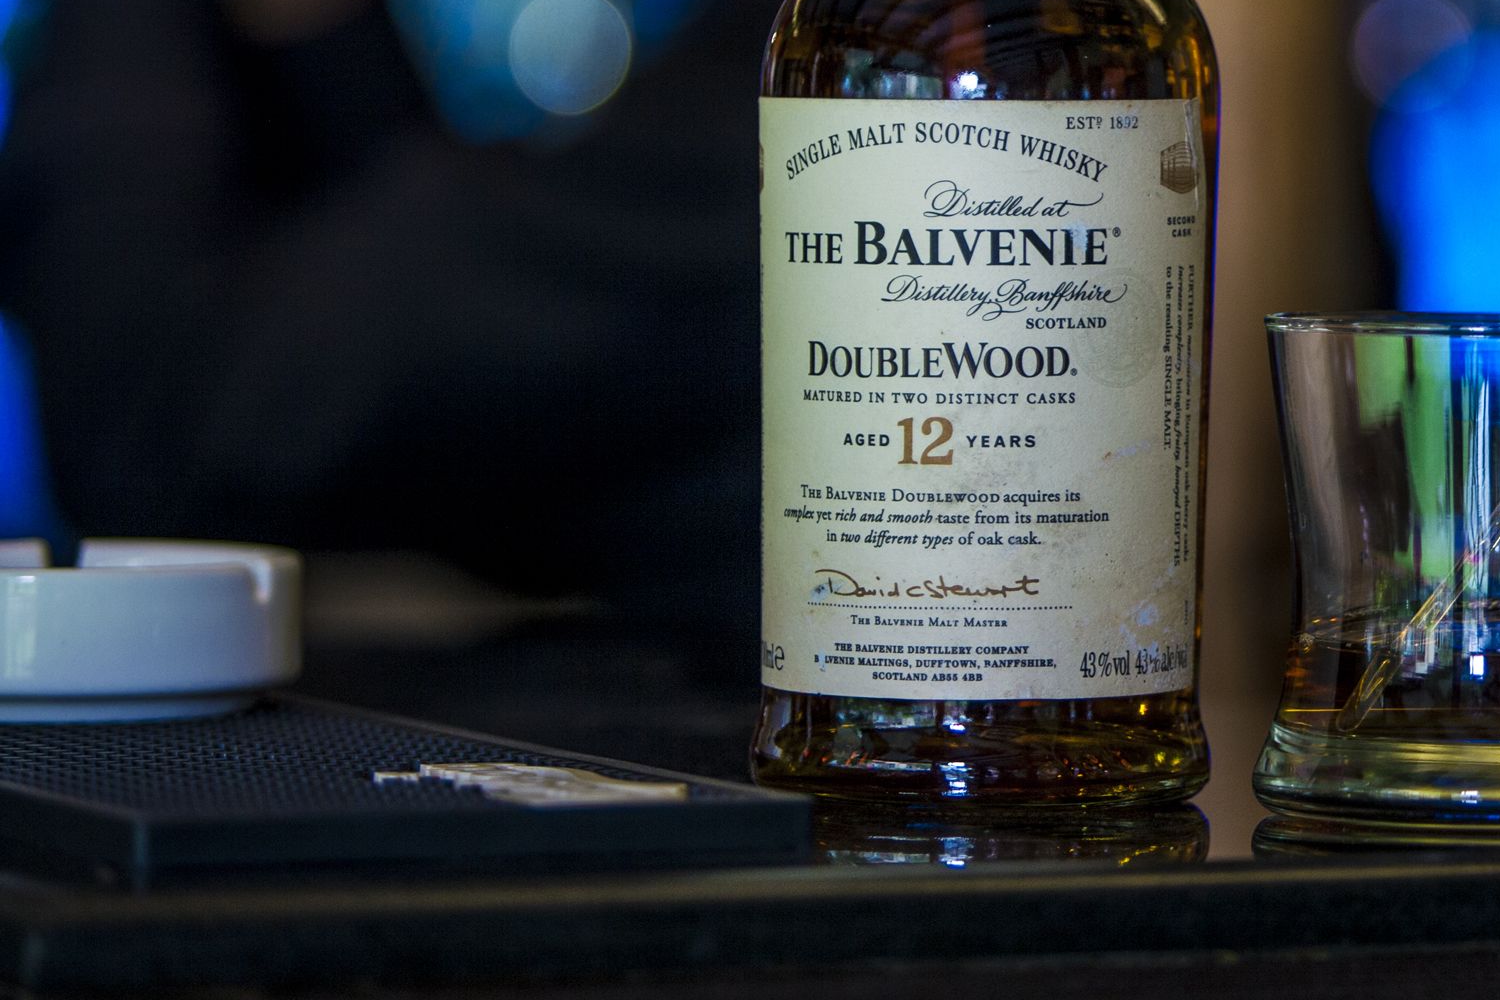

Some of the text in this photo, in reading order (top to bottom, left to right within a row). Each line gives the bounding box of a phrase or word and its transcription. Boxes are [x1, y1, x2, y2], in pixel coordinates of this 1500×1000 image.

[1110, 116, 1138, 129] 1892
[785, 122, 1108, 183] SINGLE MALT SCOTCH WHISKY
[923, 180, 1103, 217] Distilled at
[1167, 216, 1196, 226] SECOND
[1171, 229, 1192, 238] CASK
[785, 221, 1108, 266] THE BALVENIE
[1166, 266, 1172, 278] to
[881, 274, 1127, 321] Distillery, Banffshire
[1026, 317, 1107, 329] SCOTLAND
[1163, 303, 1173, 353] resulting
[1164, 355, 1172, 407] SINGLE
[803, 389, 1076, 405] MATURED IN TWO DISTINCT CASKS
[1163, 410, 1172, 450] MALT.
[843, 416, 1036, 466] AGED 12 YEARS
[826, 486, 886, 501] BALVENIE
[892, 488, 1000, 503] DOUBLEWOOD
[1003, 490, 1060, 506] acquires
[1065, 489, 1081, 502] its
[783, 505, 1109, 524] complex yet rich and smooth taste from its maturation
[826, 529, 1042, 550] in two different types of oak cask.
[814, 569, 900, 598] David
[923, 575, 1040, 599] Stewart
[874, 616, 924, 627] BALVENIE
[928, 617, 959, 628] MALT
[963, 617, 1008, 628] MASTER
[834, 643, 1029, 655] THE BALVENIE DISTILLERY COMPANY
[814, 654, 855, 665] BLVENIE
[857, 658, 912, 669] MALTINGS,
[915, 659, 981, 669] DUFFTOWN,
[872, 672, 983, 682] SCOTLAND AB55 4BB
